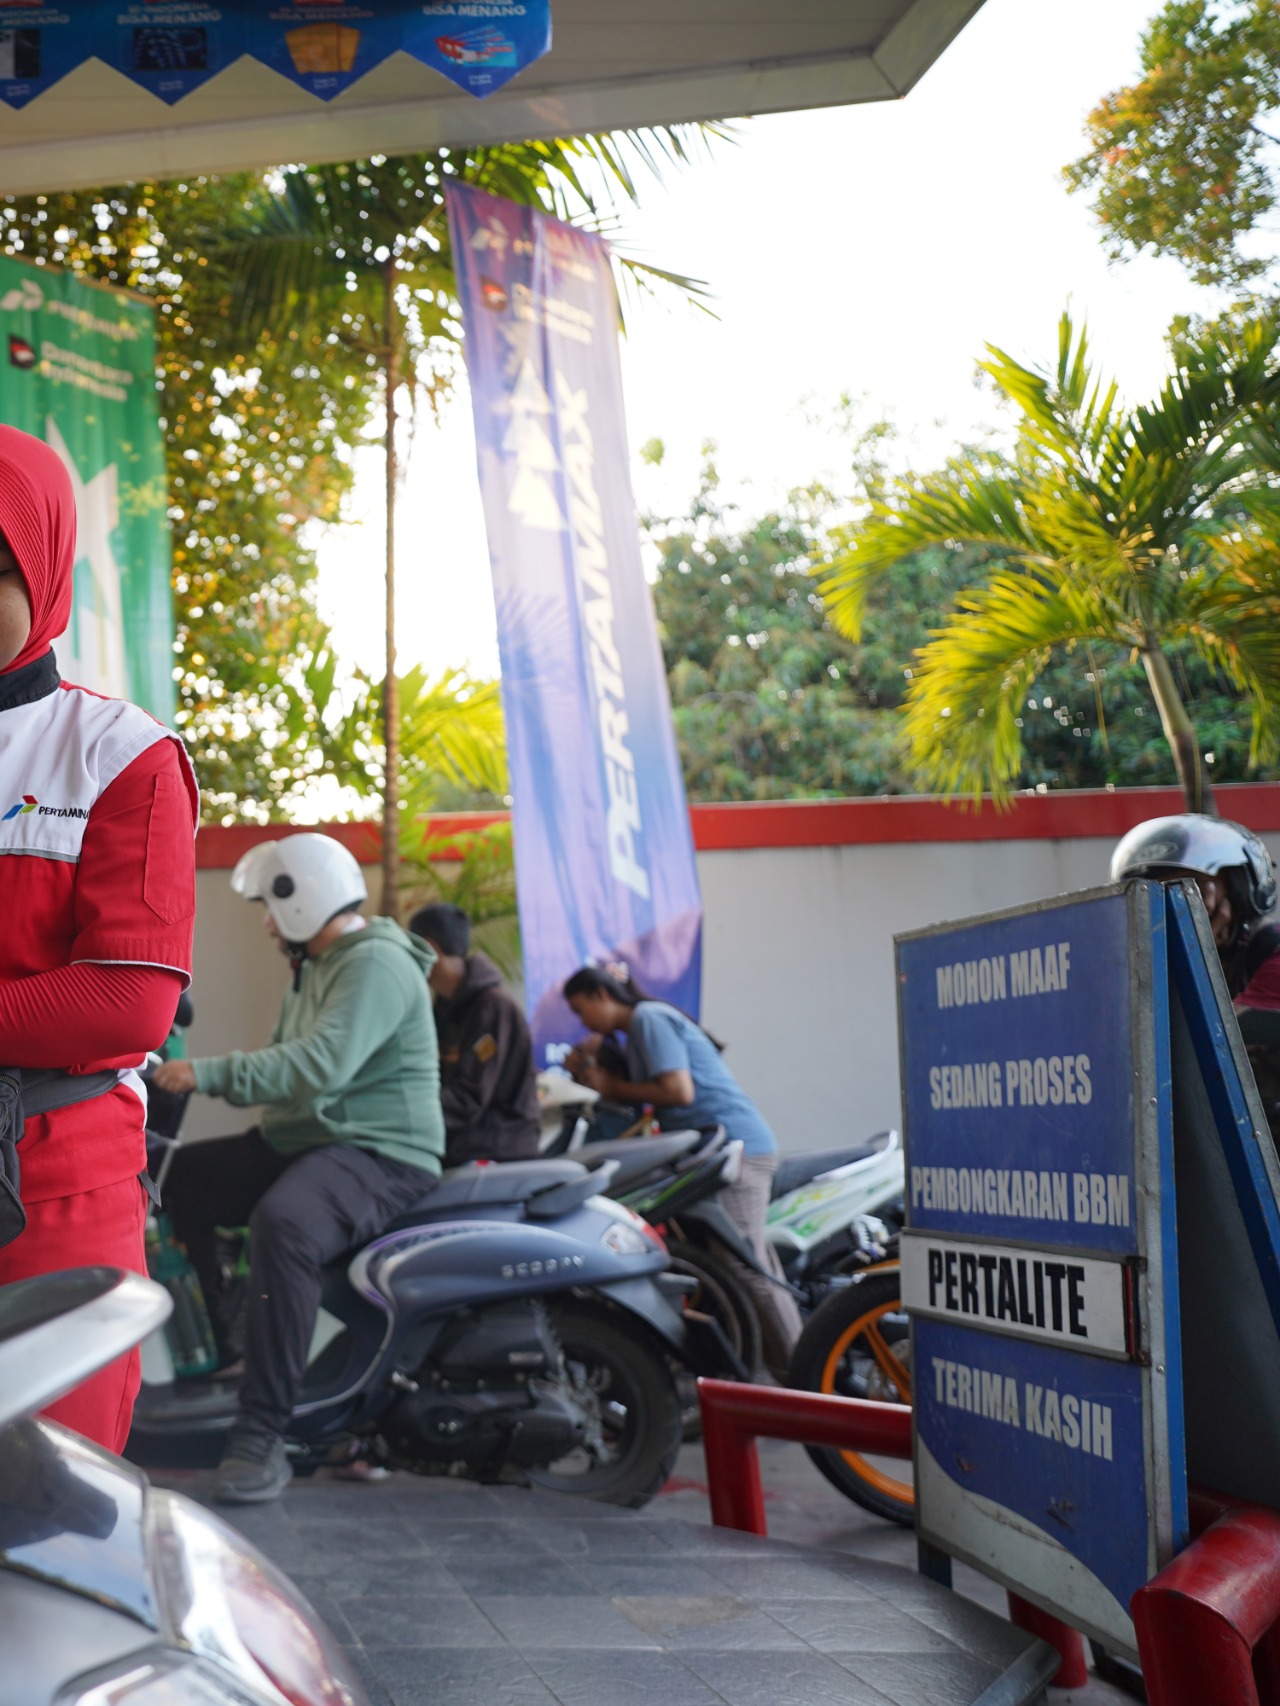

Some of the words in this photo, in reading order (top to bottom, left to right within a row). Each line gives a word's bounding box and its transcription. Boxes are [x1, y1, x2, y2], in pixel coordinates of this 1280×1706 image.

[458, 5, 527, 16] MENANG
[553, 366, 650, 900] PERTAMAX
[936, 956, 1006, 1009] MOHON
[1010, 942, 1071, 998] MAAF
[929, 1061, 1002, 1110] SEDANG
[1006, 1054, 1092, 1106] PROSES
[911, 1166, 1068, 1221] PEMBONGKARAN
[1074, 1173, 1130, 1227] BBM
[928, 1248, 1088, 1339] PERTALITE
[931, 1356, 1020, 1429] TERIMA
[1025, 1382, 1113, 1462] KASIH
